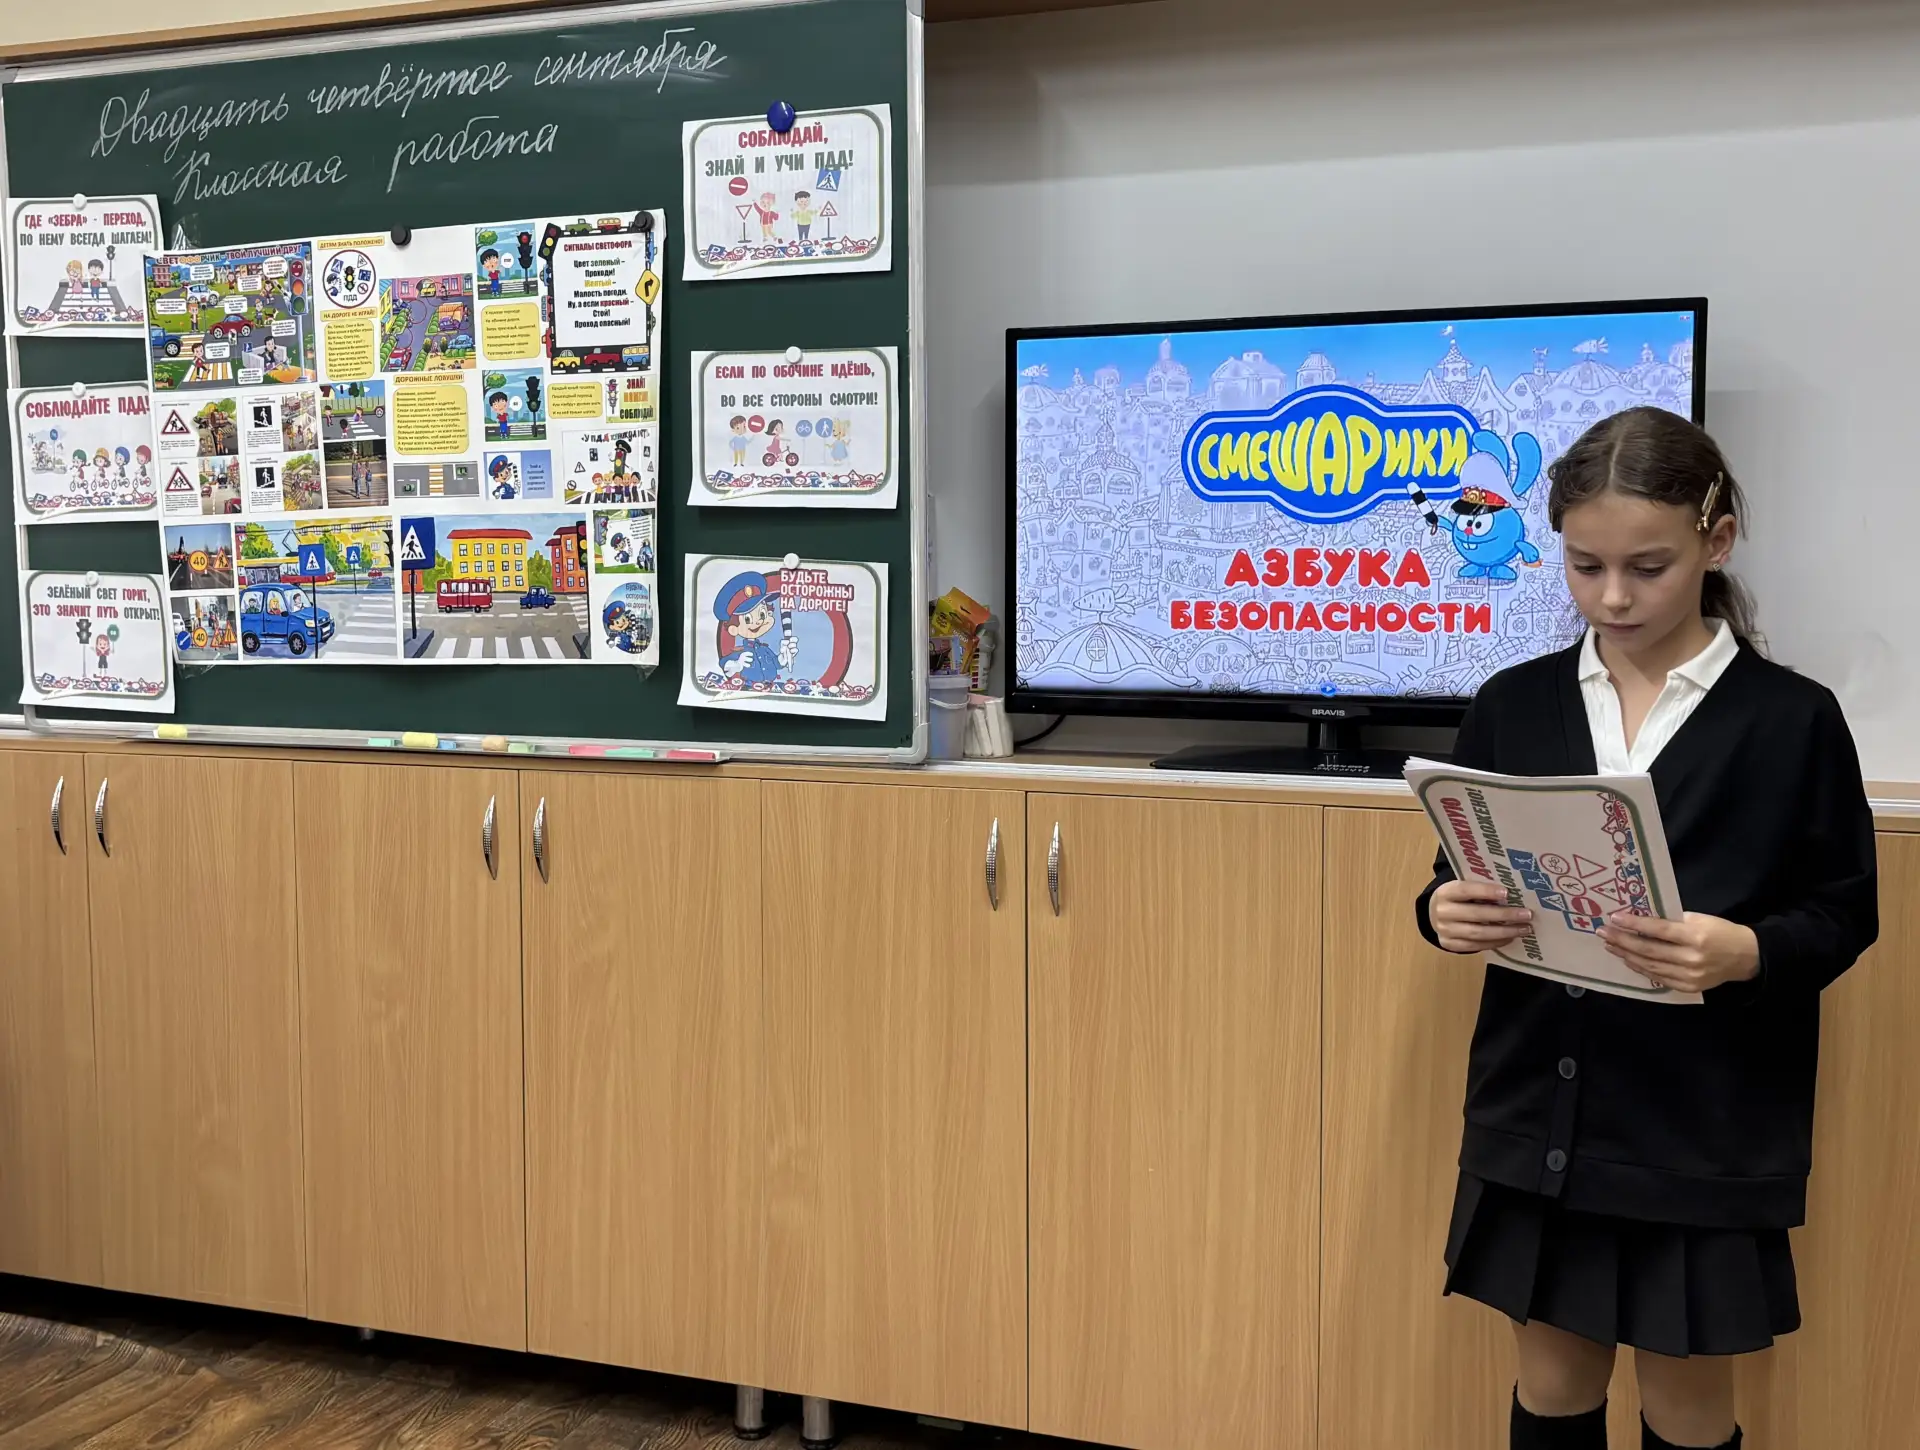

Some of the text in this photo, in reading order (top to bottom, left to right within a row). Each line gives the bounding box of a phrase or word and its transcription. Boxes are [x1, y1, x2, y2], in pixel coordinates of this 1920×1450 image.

[91, 28, 728, 163] Двадцать четвёртое сентября
[738, 122, 828, 149] СОБЛЮДАЙ,
[172, 116, 558, 205] Классная работа
[705, 149, 854, 177] ЗНАЙ И УЧИ ПДД!
[24, 215, 42, 229] ГДЕ
[48, 214, 88, 227] «ЗЕБРА»
[103, 212, 147, 227] ПЕРЕХОД,
[20, 231, 152, 247] ПО НЕМУ ВСЕГДА ШАГАЕМ!
[564, 240, 632, 252] СИГНАЛЫ СВЕТОФОРА
[283, 244, 302, 255] ДРУГ
[574, 260, 589, 268] Цвет
[585, 268, 615, 277] Проходи!
[574, 290, 602, 298] Малость
[600, 297, 629, 307] красный
[593, 309, 610, 317] Стой!
[575, 320, 598, 328] Проход
[715, 361, 875, 379] ЕСЛИ ПО ОБОЧИНЕ ИДЁШЬ,
[26, 395, 150, 419] СОБЛЮДАЙТЕ ПДД!
[721, 392, 878, 408] ВО ВСЕ СТОРОНЫ СМОТРИ!
[1198, 412, 1468, 496] СМЕШАРИКИ
[193, 556, 206, 566] 40
[1223, 547, 1431, 588] АЗБУКА
[781, 571, 827, 585] БУДЬТЕ
[47, 585, 150, 603] ЗЕЛЁНЫЙ СВЕТ ГОРИТ,
[780, 583, 852, 599] ОСТОРОЖНЫ
[33, 604, 160, 621] ЭТО ЗНАЧИТ ПУТЬ ОТКРЫТ!
[781, 598, 847, 612] НА ДОРОГЕ!
[1170, 600, 1492, 634] БЕЗОПАСНОСТИ
[196, 633, 205, 641] 40
[1312, 708, 1345, 717] BRAVIS
[1465, 787, 1506, 857] ПОЛОЖЕНО!
[1440, 797, 1494, 881] ДОРОЖНУЮ
